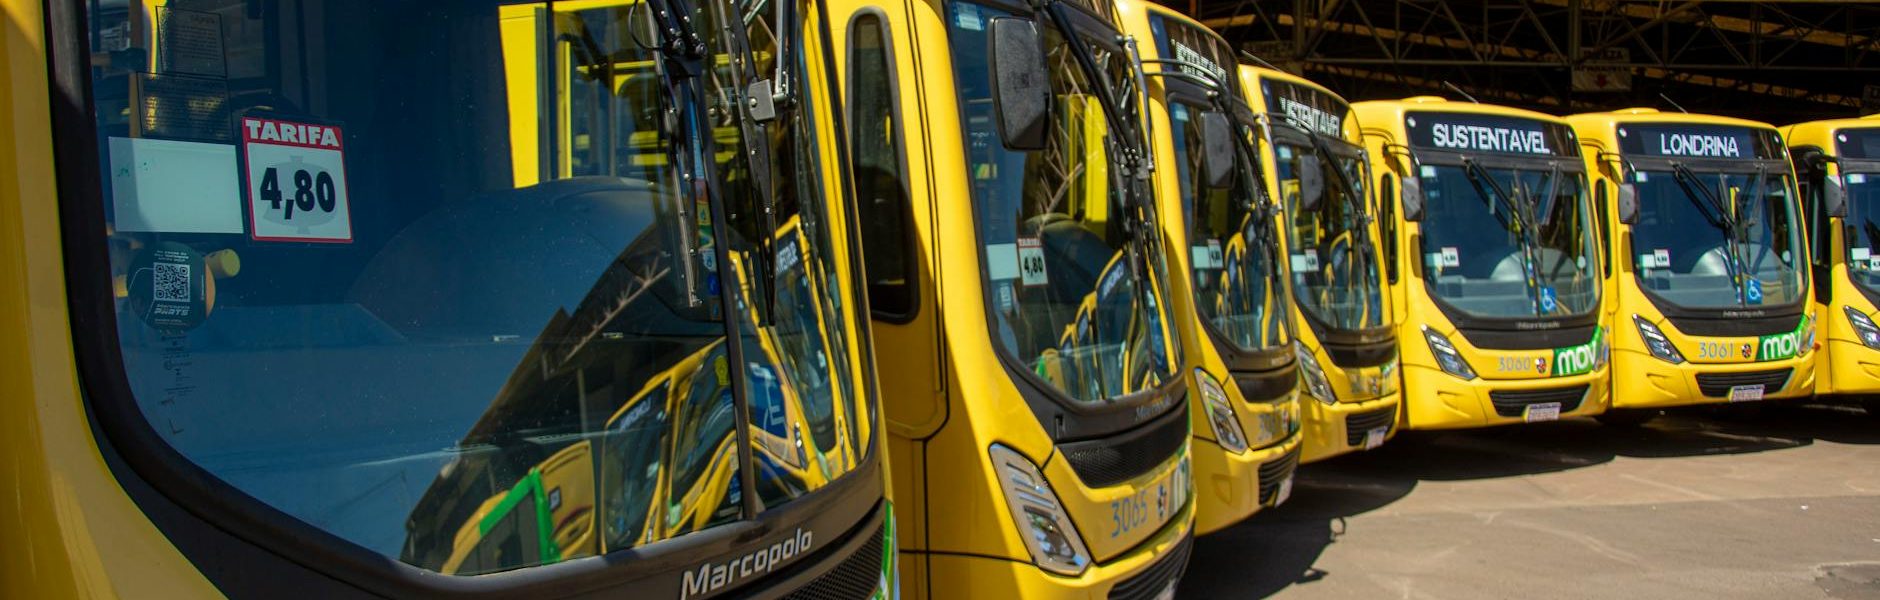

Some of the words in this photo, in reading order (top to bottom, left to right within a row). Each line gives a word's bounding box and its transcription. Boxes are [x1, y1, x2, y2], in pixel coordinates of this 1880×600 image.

[246, 119, 340, 147] TARIFA
[1432, 123, 1551, 154] SUSTENTAVEL
[1660, 133, 1740, 158] LONDRINA
[260, 167, 336, 220] 4,80
[1024, 256, 1044, 277] 4,80
[1498, 356, 1531, 372] 3060
[1699, 342, 1735, 359] 3061
[1111, 489, 1148, 538] 3065
[681, 528, 813, 600] Marcopolo
